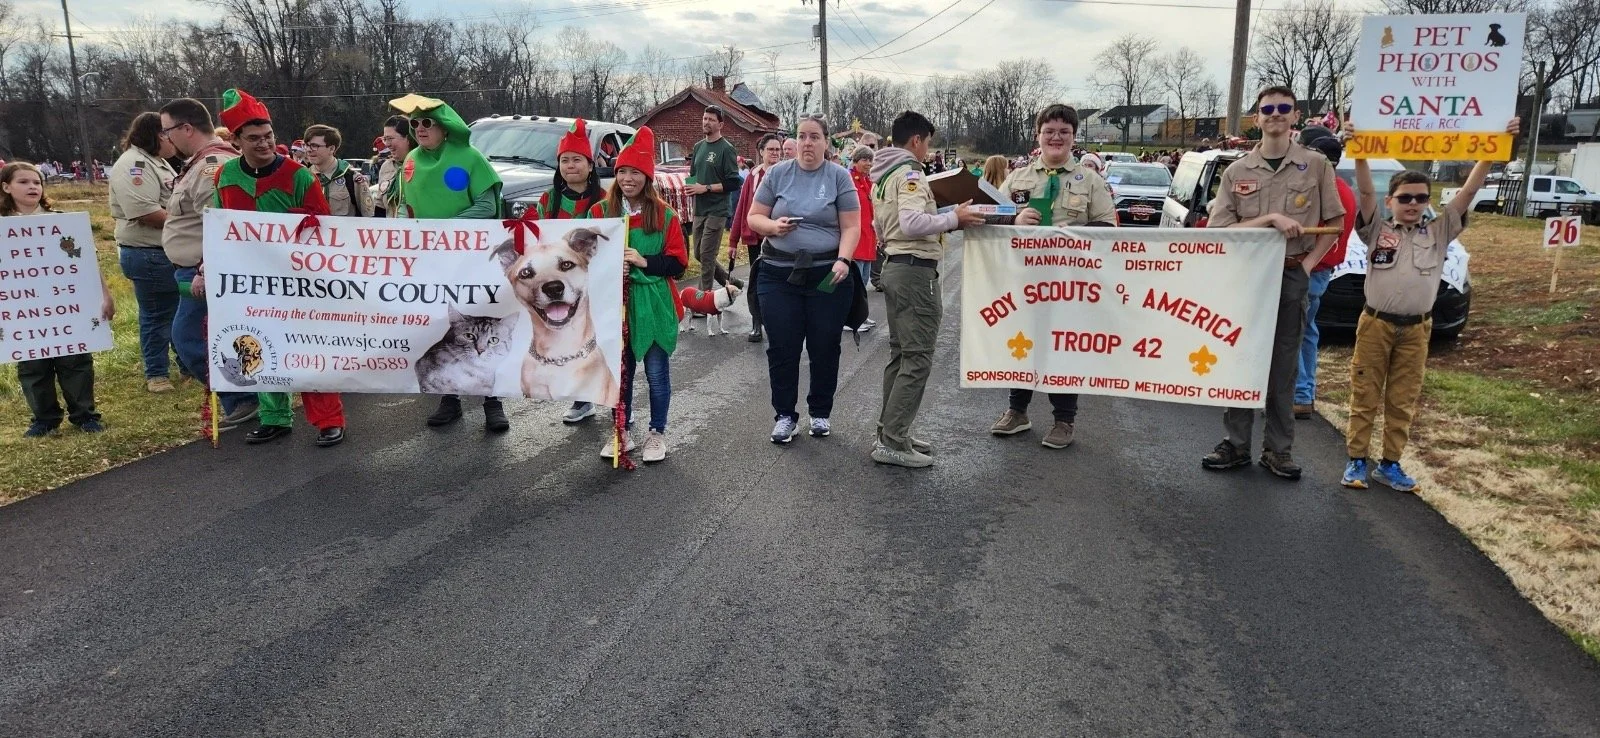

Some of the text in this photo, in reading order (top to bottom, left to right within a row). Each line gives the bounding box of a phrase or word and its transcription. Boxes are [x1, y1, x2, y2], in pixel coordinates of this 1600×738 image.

[1413, 26, 1471, 46] PET
[1377, 52, 1500, 72] PHOTOS
[1411, 76, 1456, 87] WITH
[1378, 95, 1483, 116] SANTA
[1393, 118, 1422, 130] HERE
[1438, 118, 1461, 129] RCC
[1401, 135, 1435, 154] DEC.
[1441, 133, 1460, 154] 3rd
[1466, 135, 1498, 154] 3-5
[0, 225, 62, 238] ANTA
[224, 220, 490, 251] ANIMAL WELFARE
[1548, 218, 1578, 245] 26
[10, 247, 45, 259] PET
[1011, 237, 1226, 255] SHENANDOAH AREA COUNCIL
[0, 264, 79, 280] PHOTOS
[290, 250, 418, 277] SOCIETY
[1024, 255, 1183, 271] MANNAHOAC DISTRICT
[0, 284, 76, 301] SUN. 3-5
[215, 273, 501, 304] JEFFERSON COUNTY
[1, 304, 80, 321] RANSON
[245, 306, 430, 326] Serving the Community since 1952
[979, 291, 1018, 327] BOY
[1023, 280, 1102, 304] SCOUTS
[1142, 288, 1243, 347] AMERICA
[13, 325, 73, 341] CIVIC
[285, 333, 410, 352] www.awsjc.org
[11, 342, 88, 361] CENTER
[221, 324, 263, 337] WELFARE
[262, 335, 277, 373] SOCIETY
[1051, 330, 1163, 359] TROOP 42
[284, 352, 409, 372] (304) 725-0589
[966, 370, 1034, 383] SPONSORED
[1042, 374, 1086, 387] ASBURY
[1089, 378, 1130, 390] UNITED
[1134, 381, 1203, 398] METHODIST
[1208, 387, 1262, 401] CHURCH
